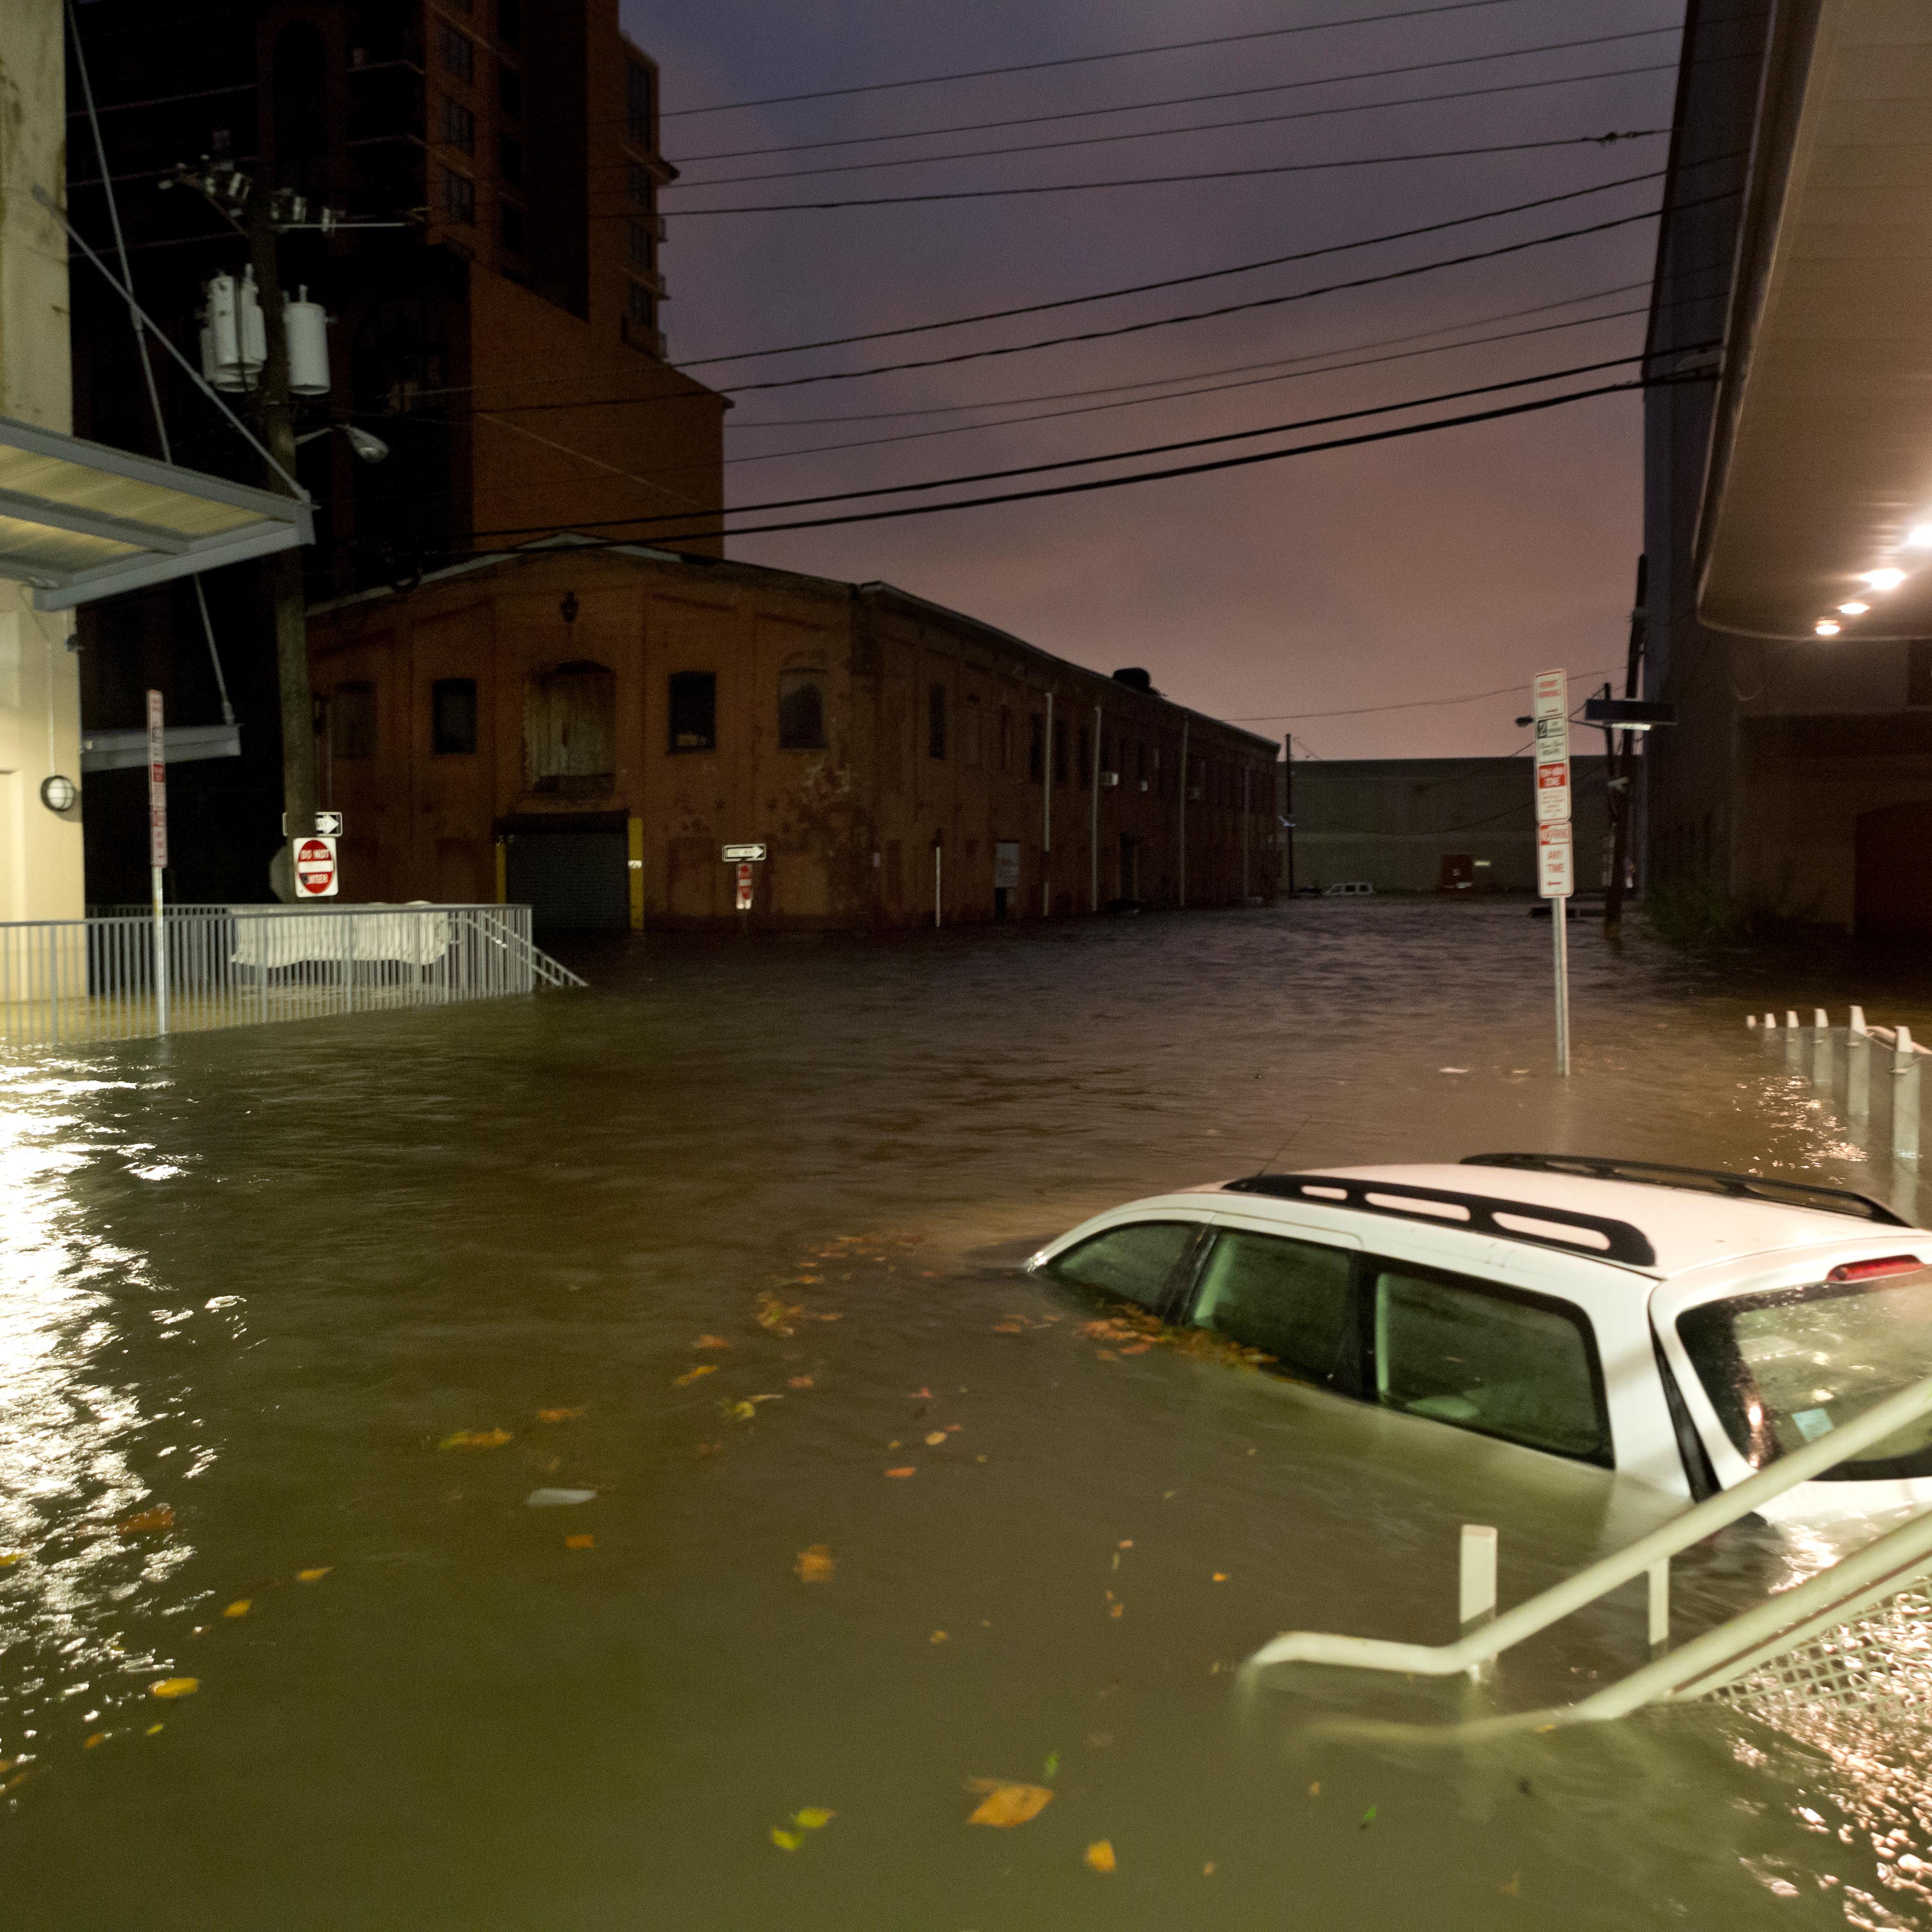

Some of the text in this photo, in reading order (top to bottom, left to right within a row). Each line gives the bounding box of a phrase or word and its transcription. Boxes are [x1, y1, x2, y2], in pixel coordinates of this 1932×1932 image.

[301, 849, 330, 859] DO NOT
[1547, 863, 1565, 873] TIME
[303, 873, 329, 884] NTER
